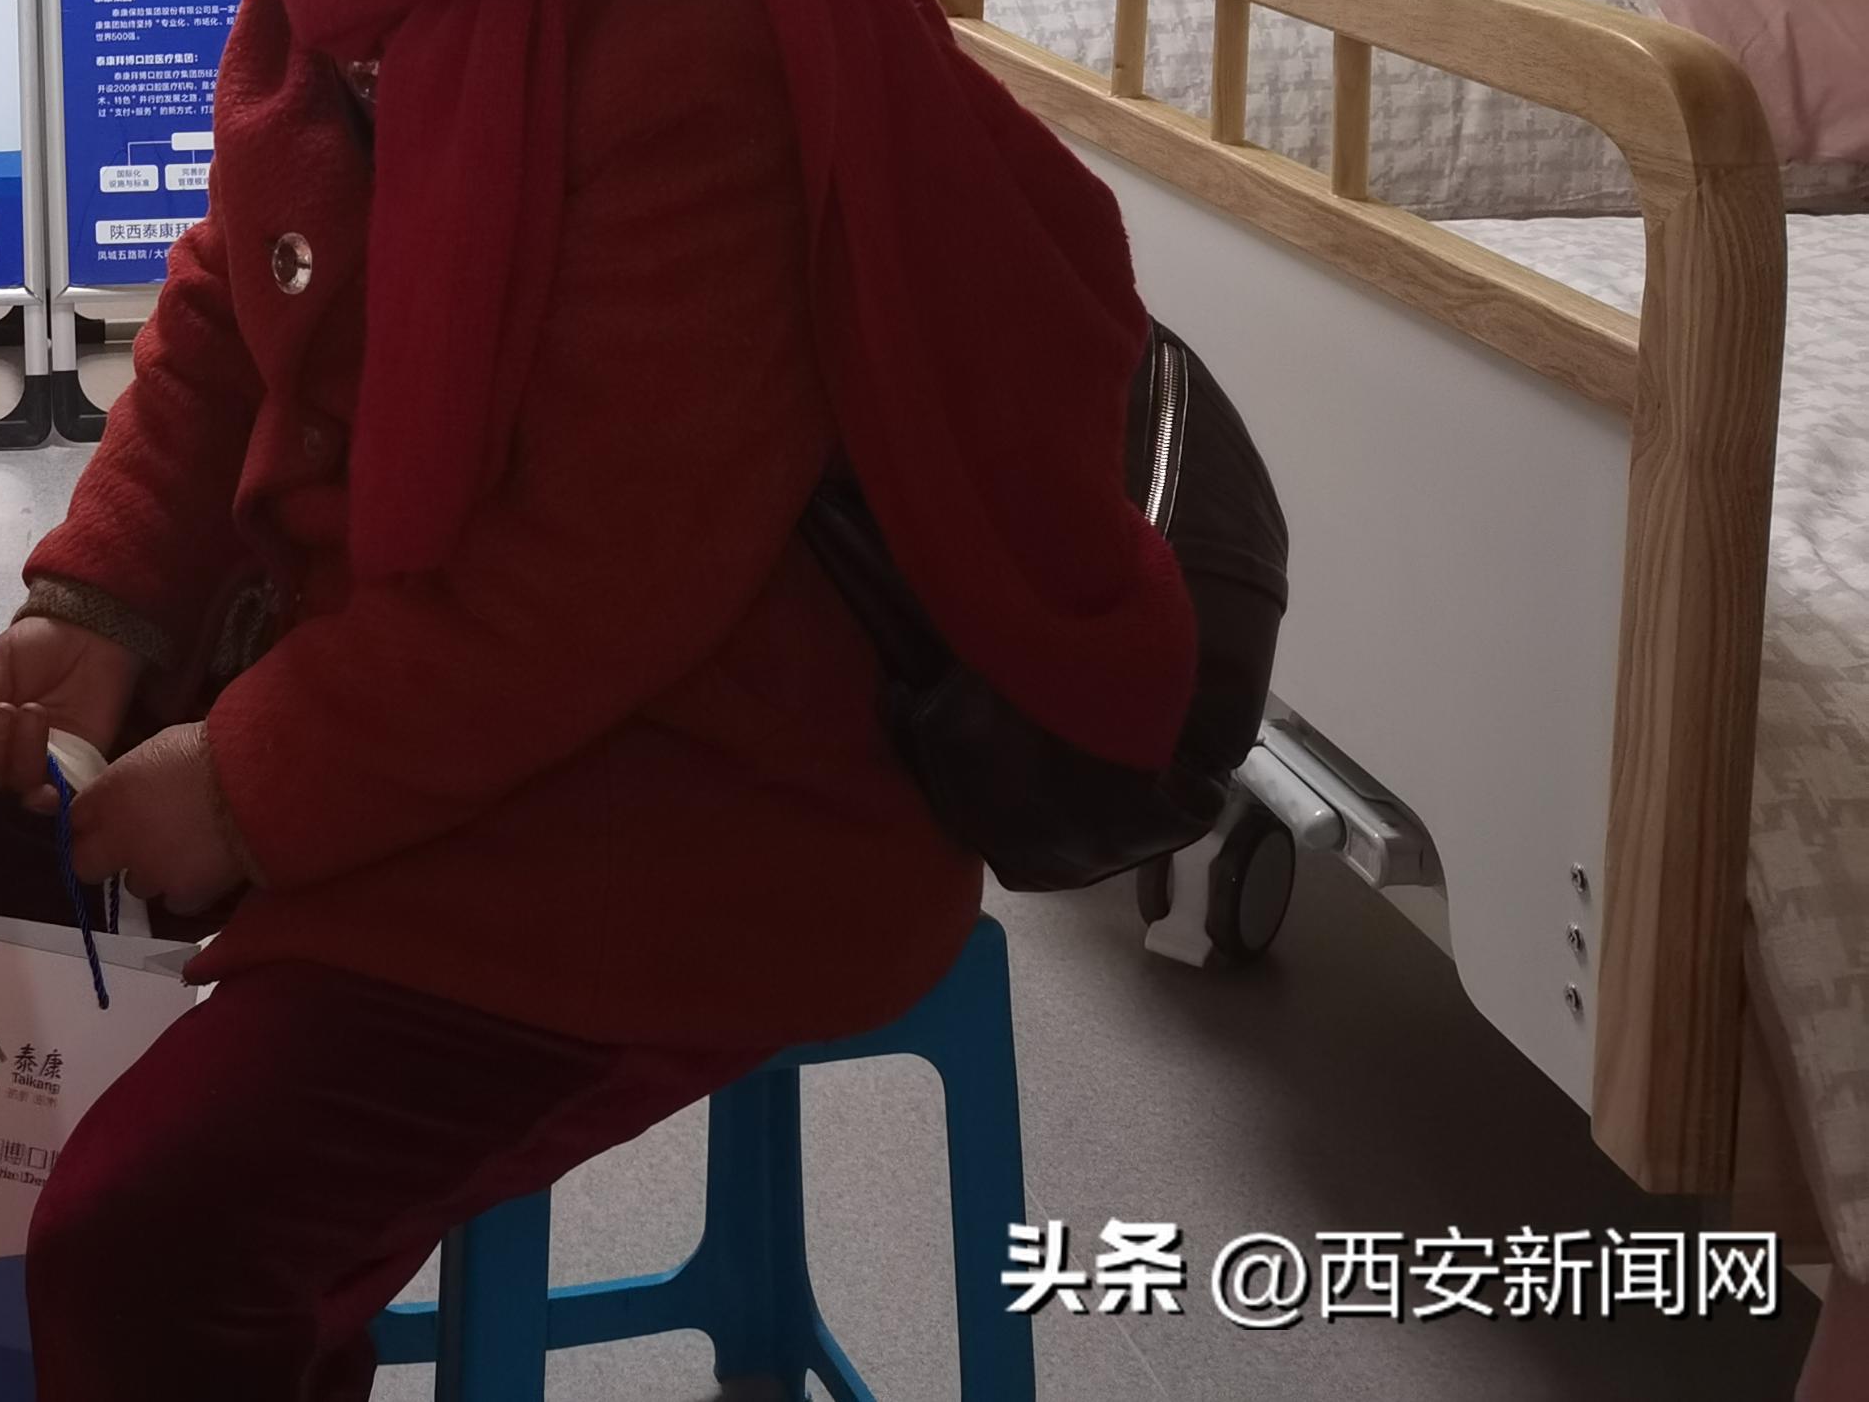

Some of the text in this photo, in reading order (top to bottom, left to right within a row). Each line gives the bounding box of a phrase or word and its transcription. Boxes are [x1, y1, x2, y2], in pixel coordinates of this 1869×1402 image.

[110, 222, 195, 240] 陕西泰康拜
[14, 1043, 64, 1080] 泰康
[11, 1072, 61, 1095] Taikang
